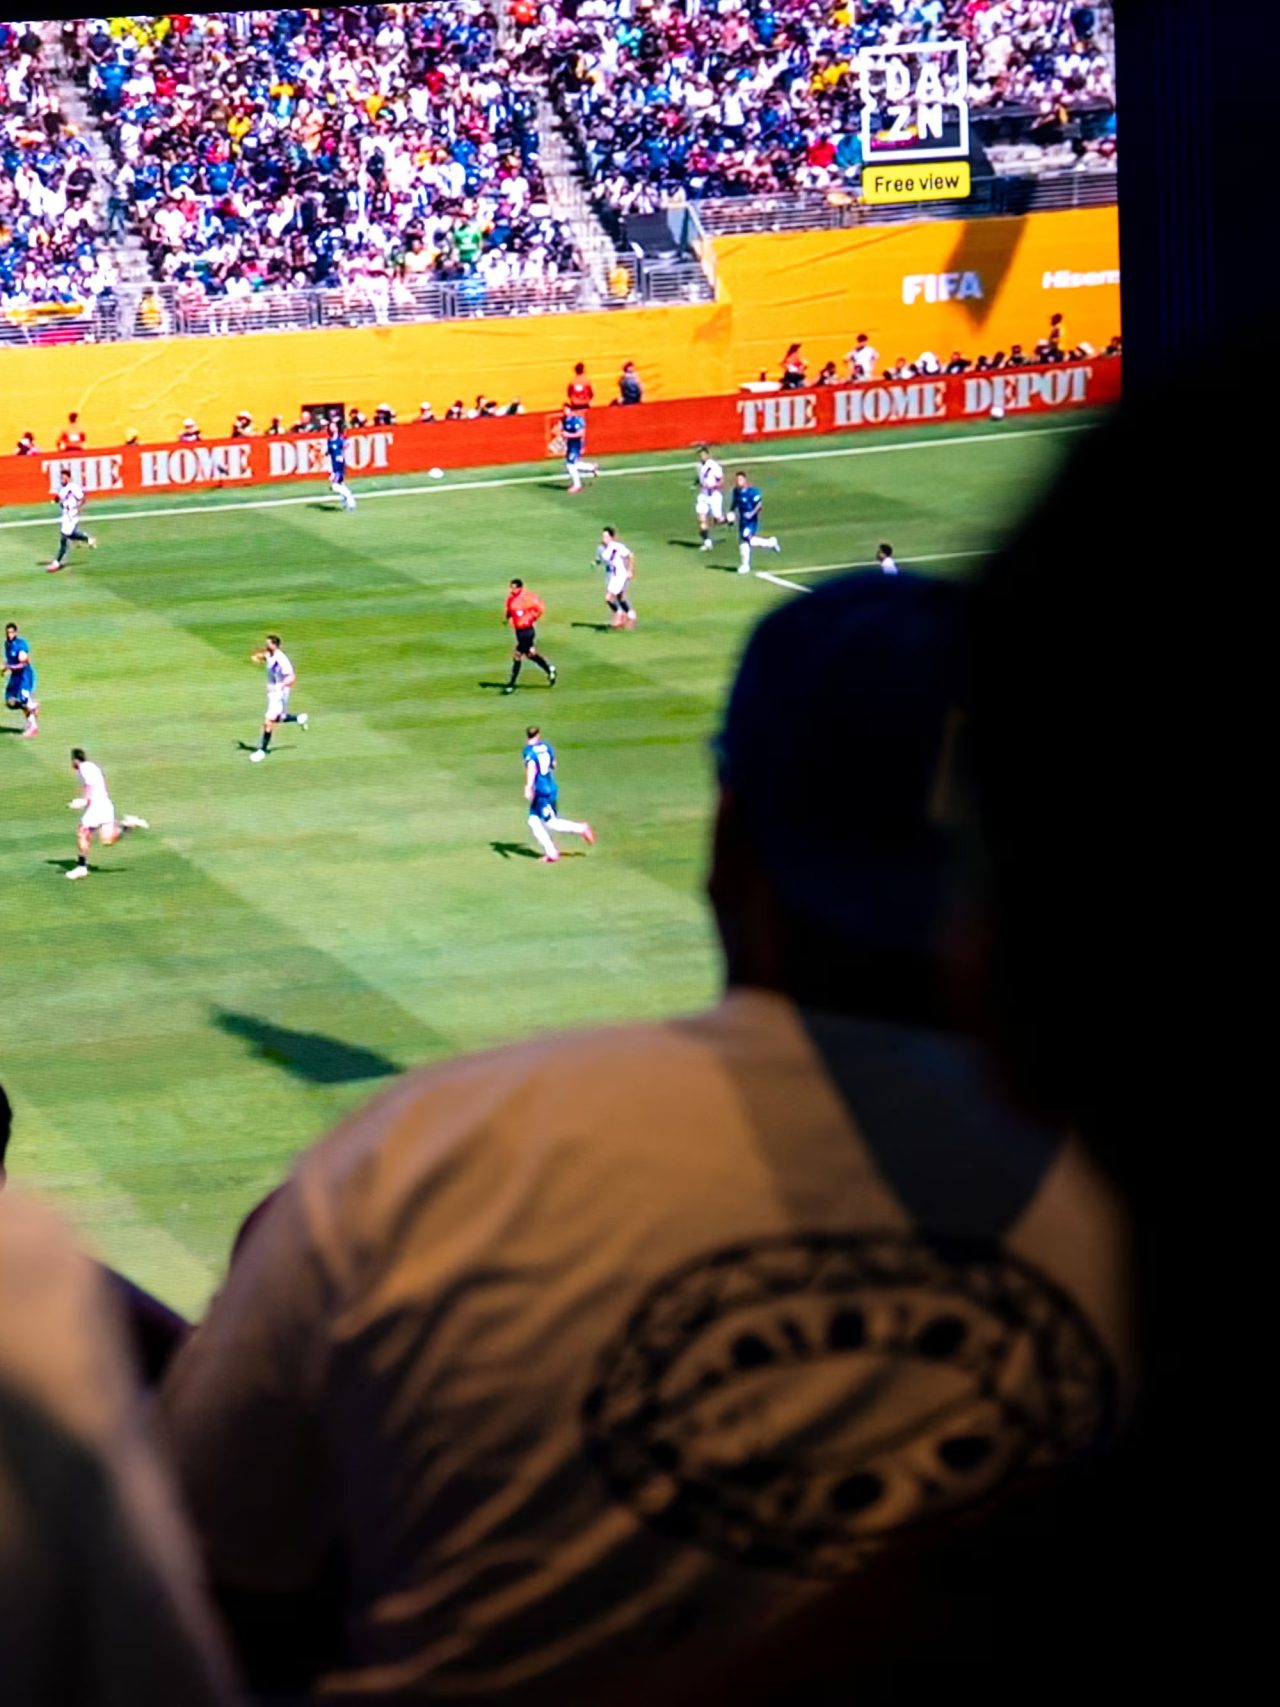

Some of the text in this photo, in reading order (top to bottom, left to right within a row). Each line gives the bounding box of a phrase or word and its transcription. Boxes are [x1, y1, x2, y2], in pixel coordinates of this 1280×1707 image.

[875, 174, 959, 193] Free view
[902, 271, 984, 305] FIFA
[737, 366, 1093, 435] THE HOME DEPOT
[41, 432, 393, 494] THE HOME DEOT
